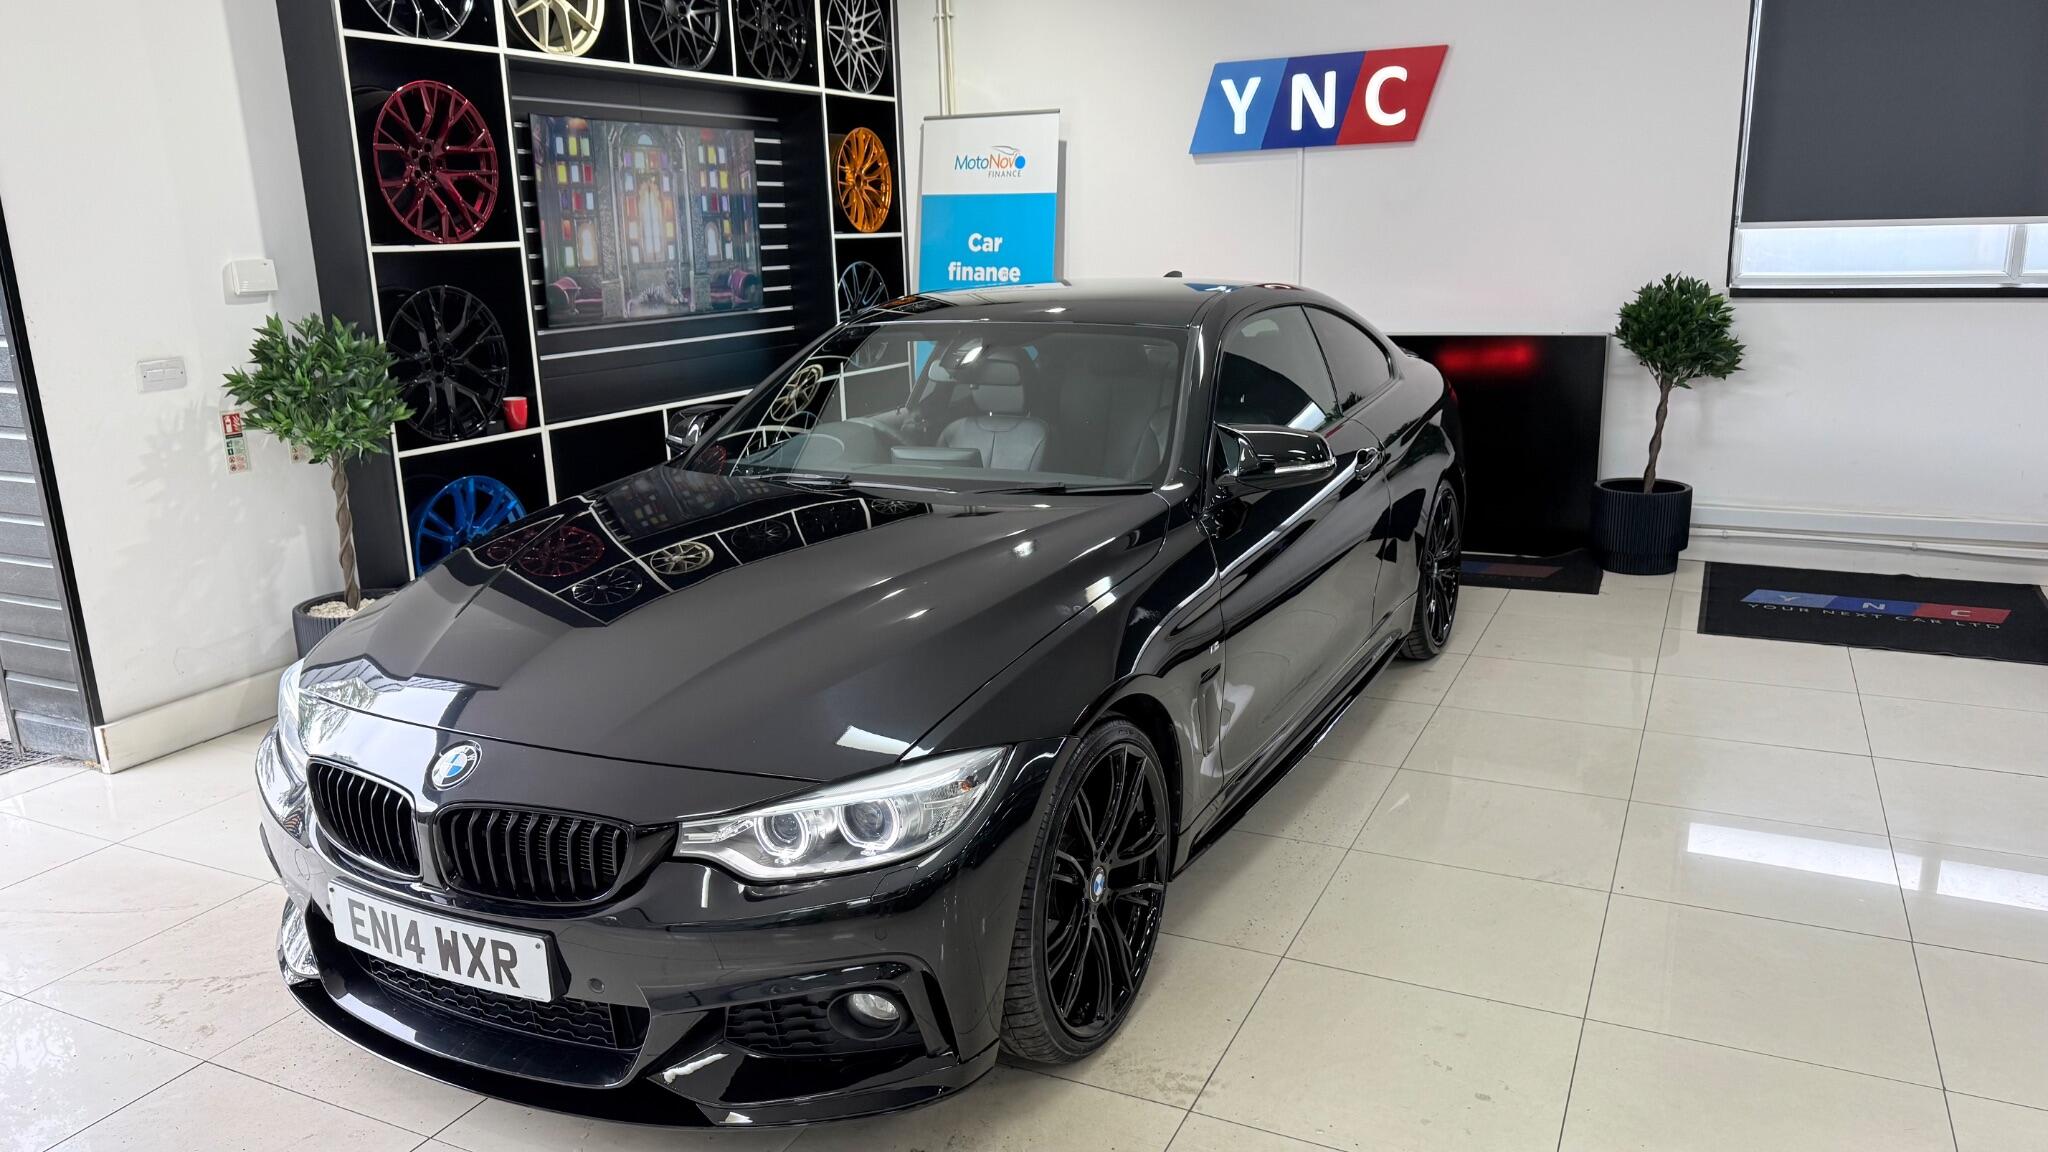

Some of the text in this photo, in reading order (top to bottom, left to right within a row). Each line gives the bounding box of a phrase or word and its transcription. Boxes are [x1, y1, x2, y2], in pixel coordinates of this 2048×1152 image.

[988, 170, 1022, 178] FINANCE
[967, 232, 1004, 252] Car
[948, 261, 1021, 283] finance
[1747, 603, 2000, 629] YOUR NEXT CAR LTD
[347, 897, 521, 989] EN14 WXR
